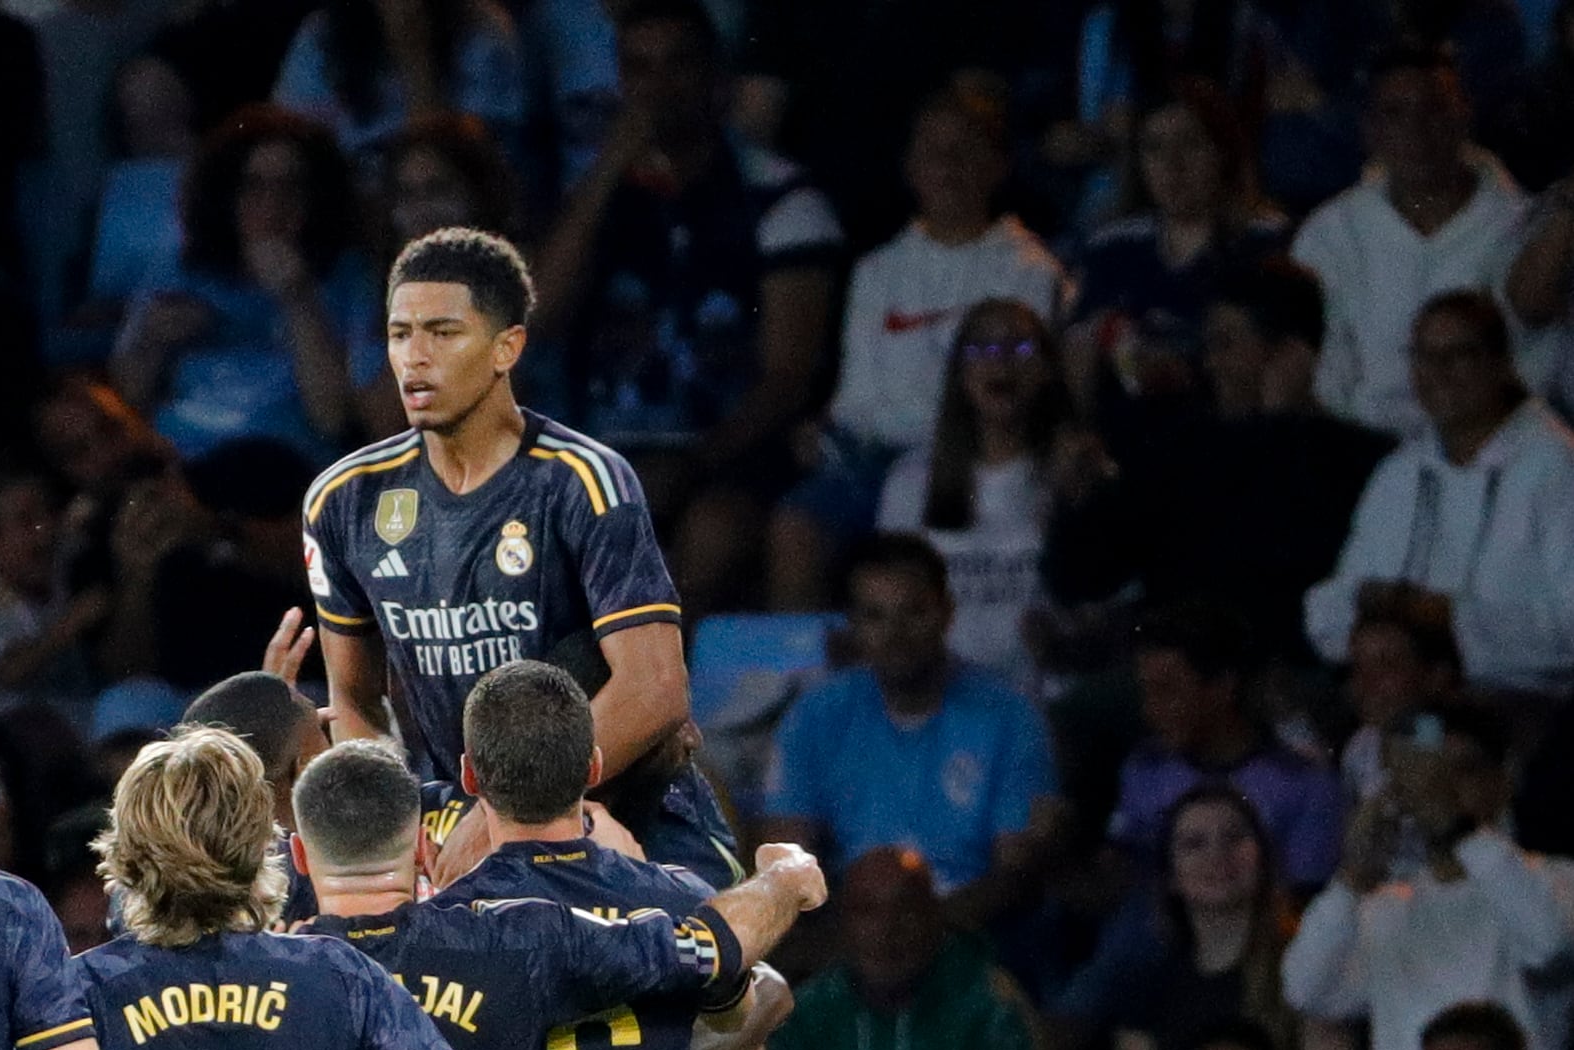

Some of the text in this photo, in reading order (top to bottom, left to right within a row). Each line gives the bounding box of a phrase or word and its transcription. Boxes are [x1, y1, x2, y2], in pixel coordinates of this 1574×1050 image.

[380, 596, 539, 640] Emirates
[415, 635, 524, 676] FLY BETTER
